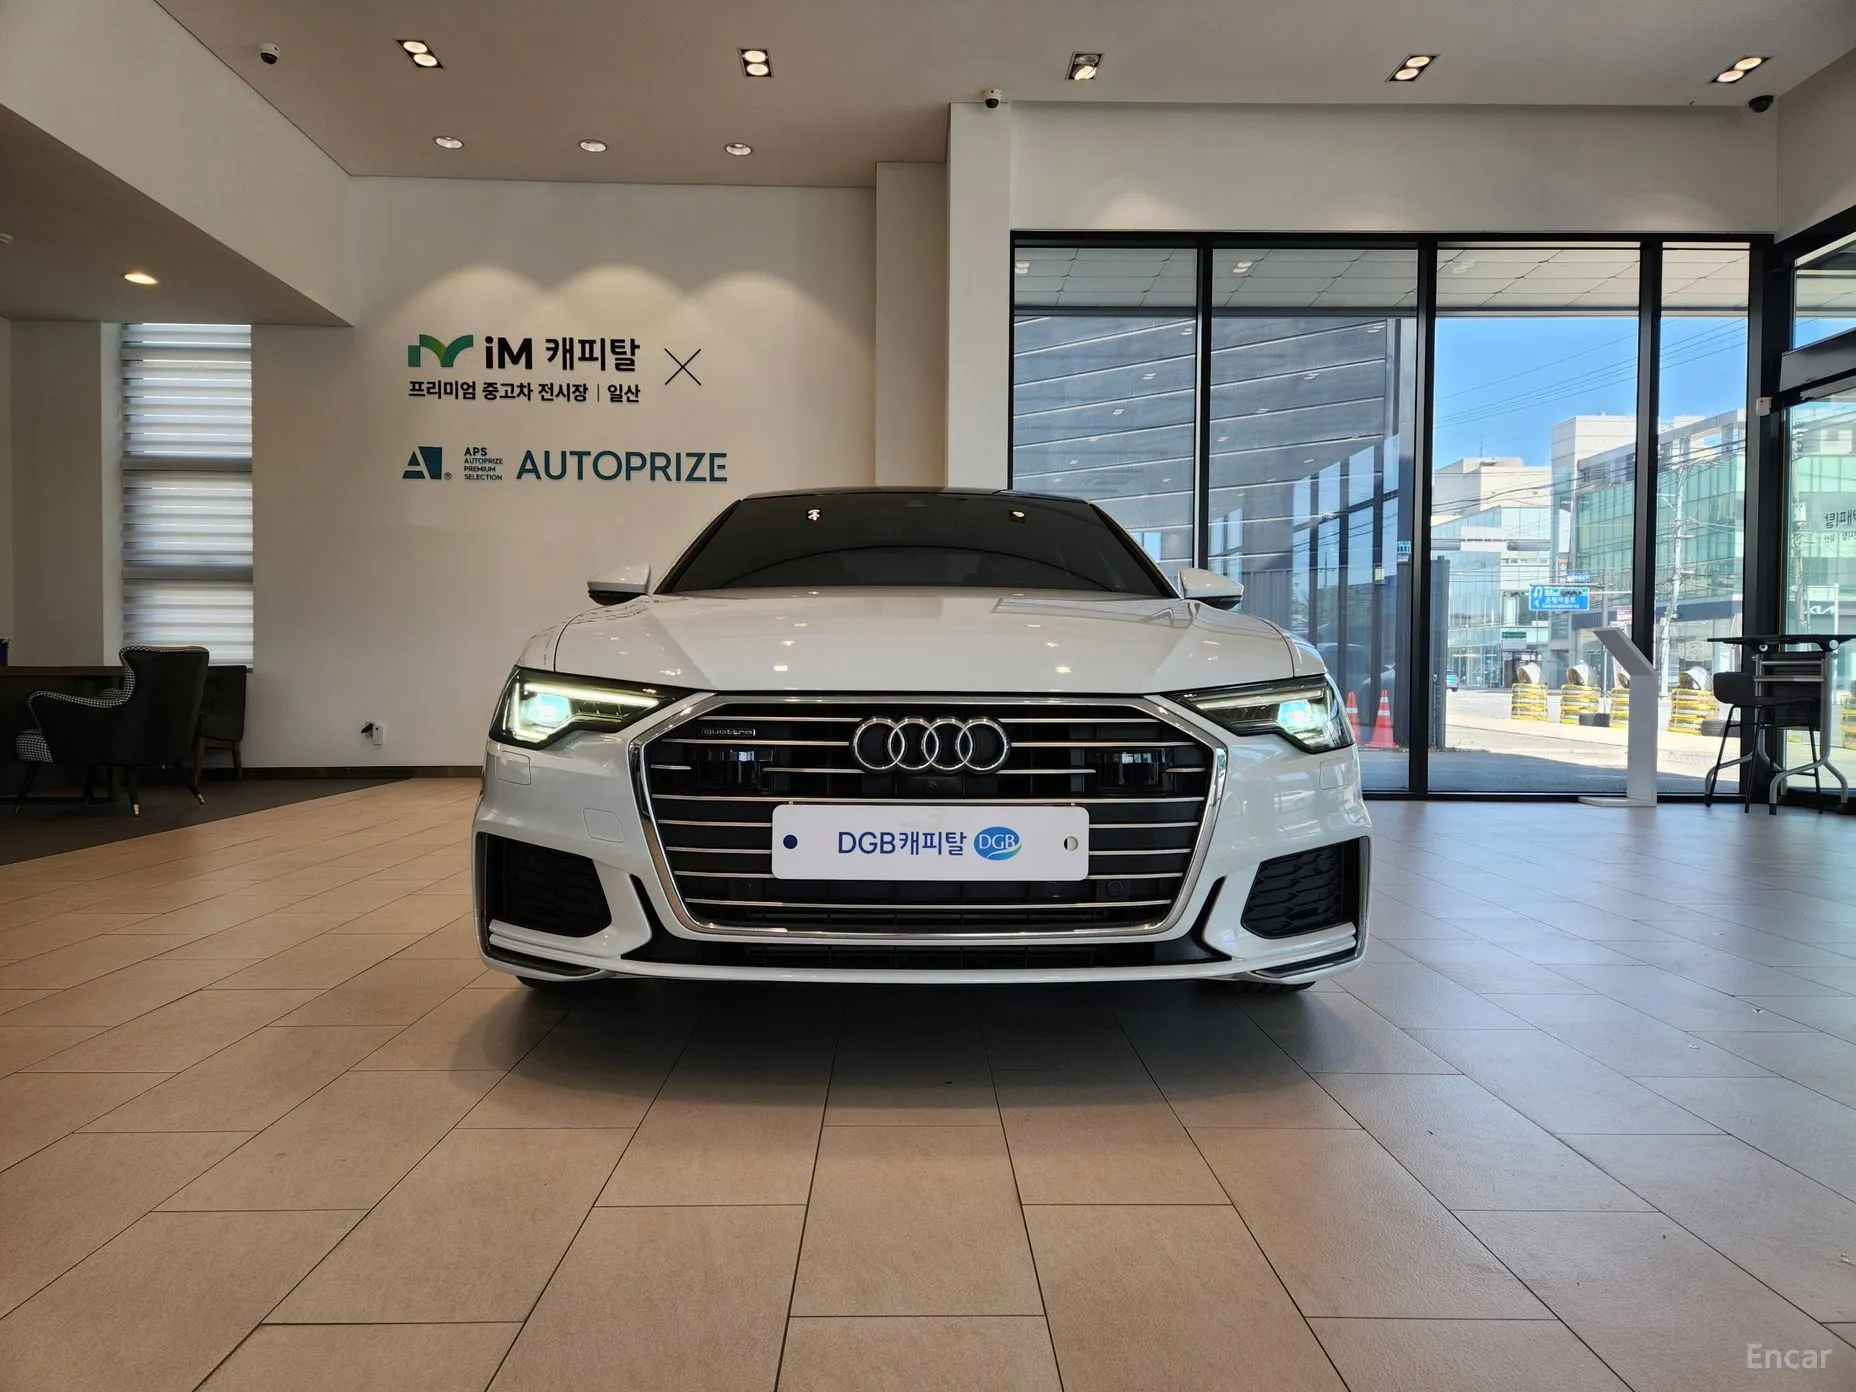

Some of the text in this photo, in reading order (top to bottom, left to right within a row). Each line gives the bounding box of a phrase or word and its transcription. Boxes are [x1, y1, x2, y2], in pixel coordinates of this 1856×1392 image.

[485, 336, 640, 372] iM 캐피탈
[408, 380, 640, 403] 프리미엄 중고차 전시장 일산
[464, 446, 488, 457] APS
[464, 457, 503, 465] AUTOPRIZE
[516, 450, 728, 482] AUTOPRIZE
[838, 831, 1015, 856] DGB캐피탈 DGB
